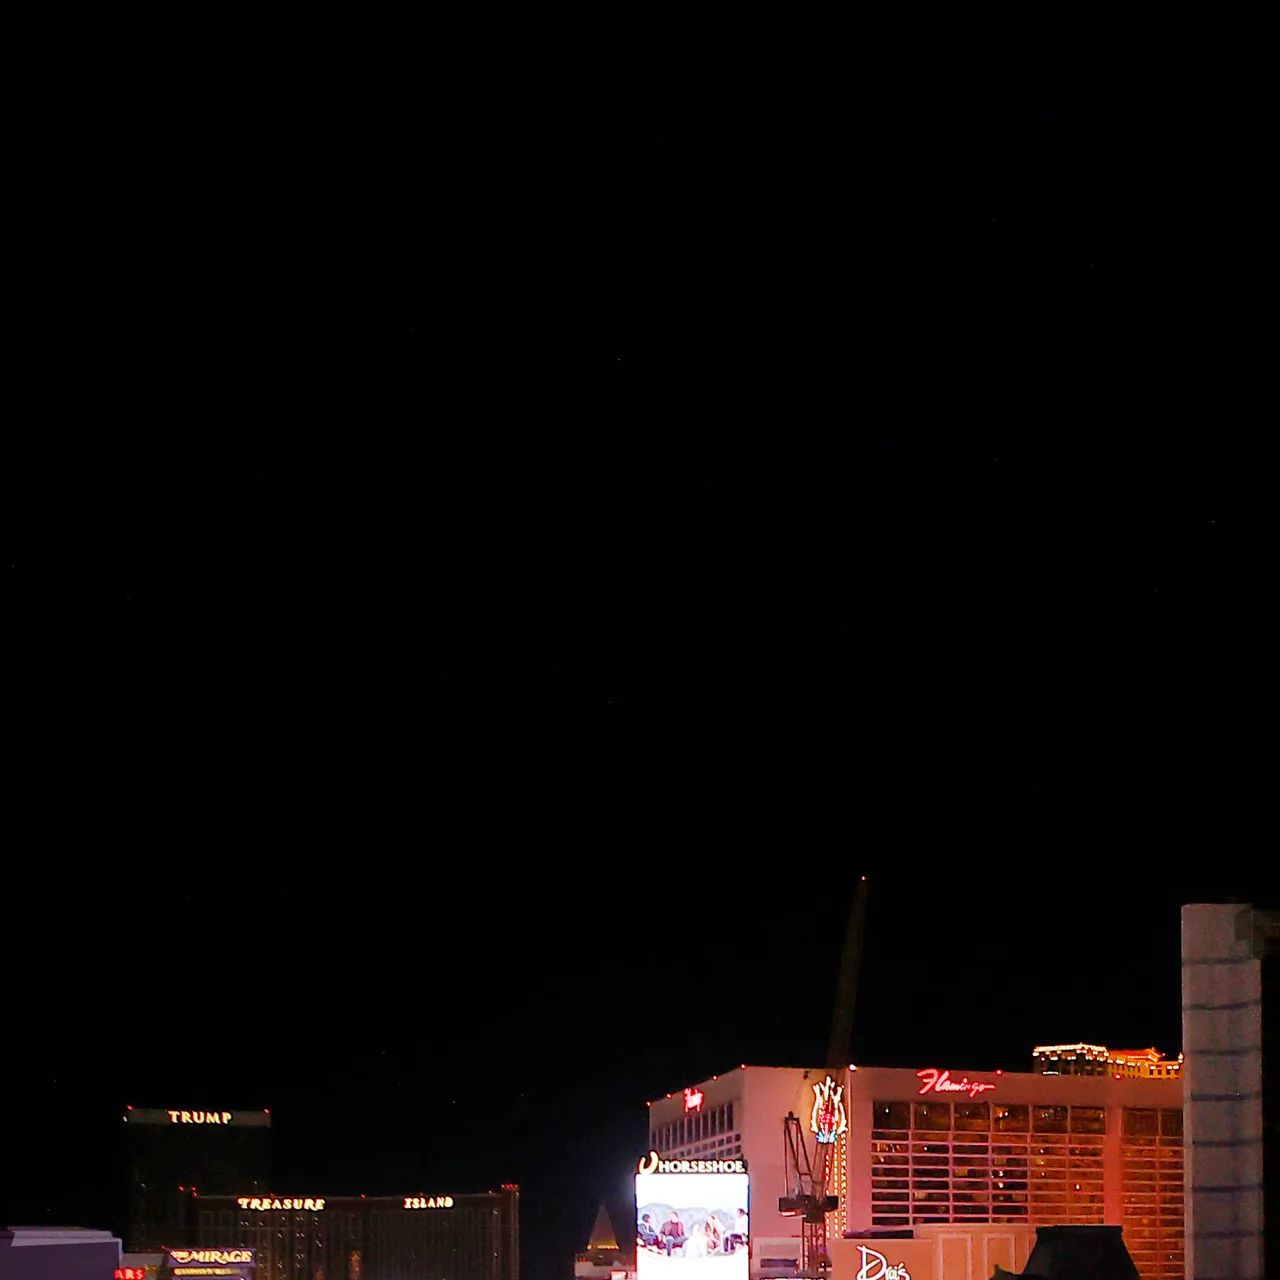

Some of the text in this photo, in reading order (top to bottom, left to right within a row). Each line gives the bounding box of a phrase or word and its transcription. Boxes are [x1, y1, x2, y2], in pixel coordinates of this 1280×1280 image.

[917, 1069, 996, 1098] Flamingo
[168, 1110, 233, 1124] TRUMP
[237, 1196, 454, 1211] TREASURE ISLAND
[190, 1250, 252, 1265] MIRAGE
